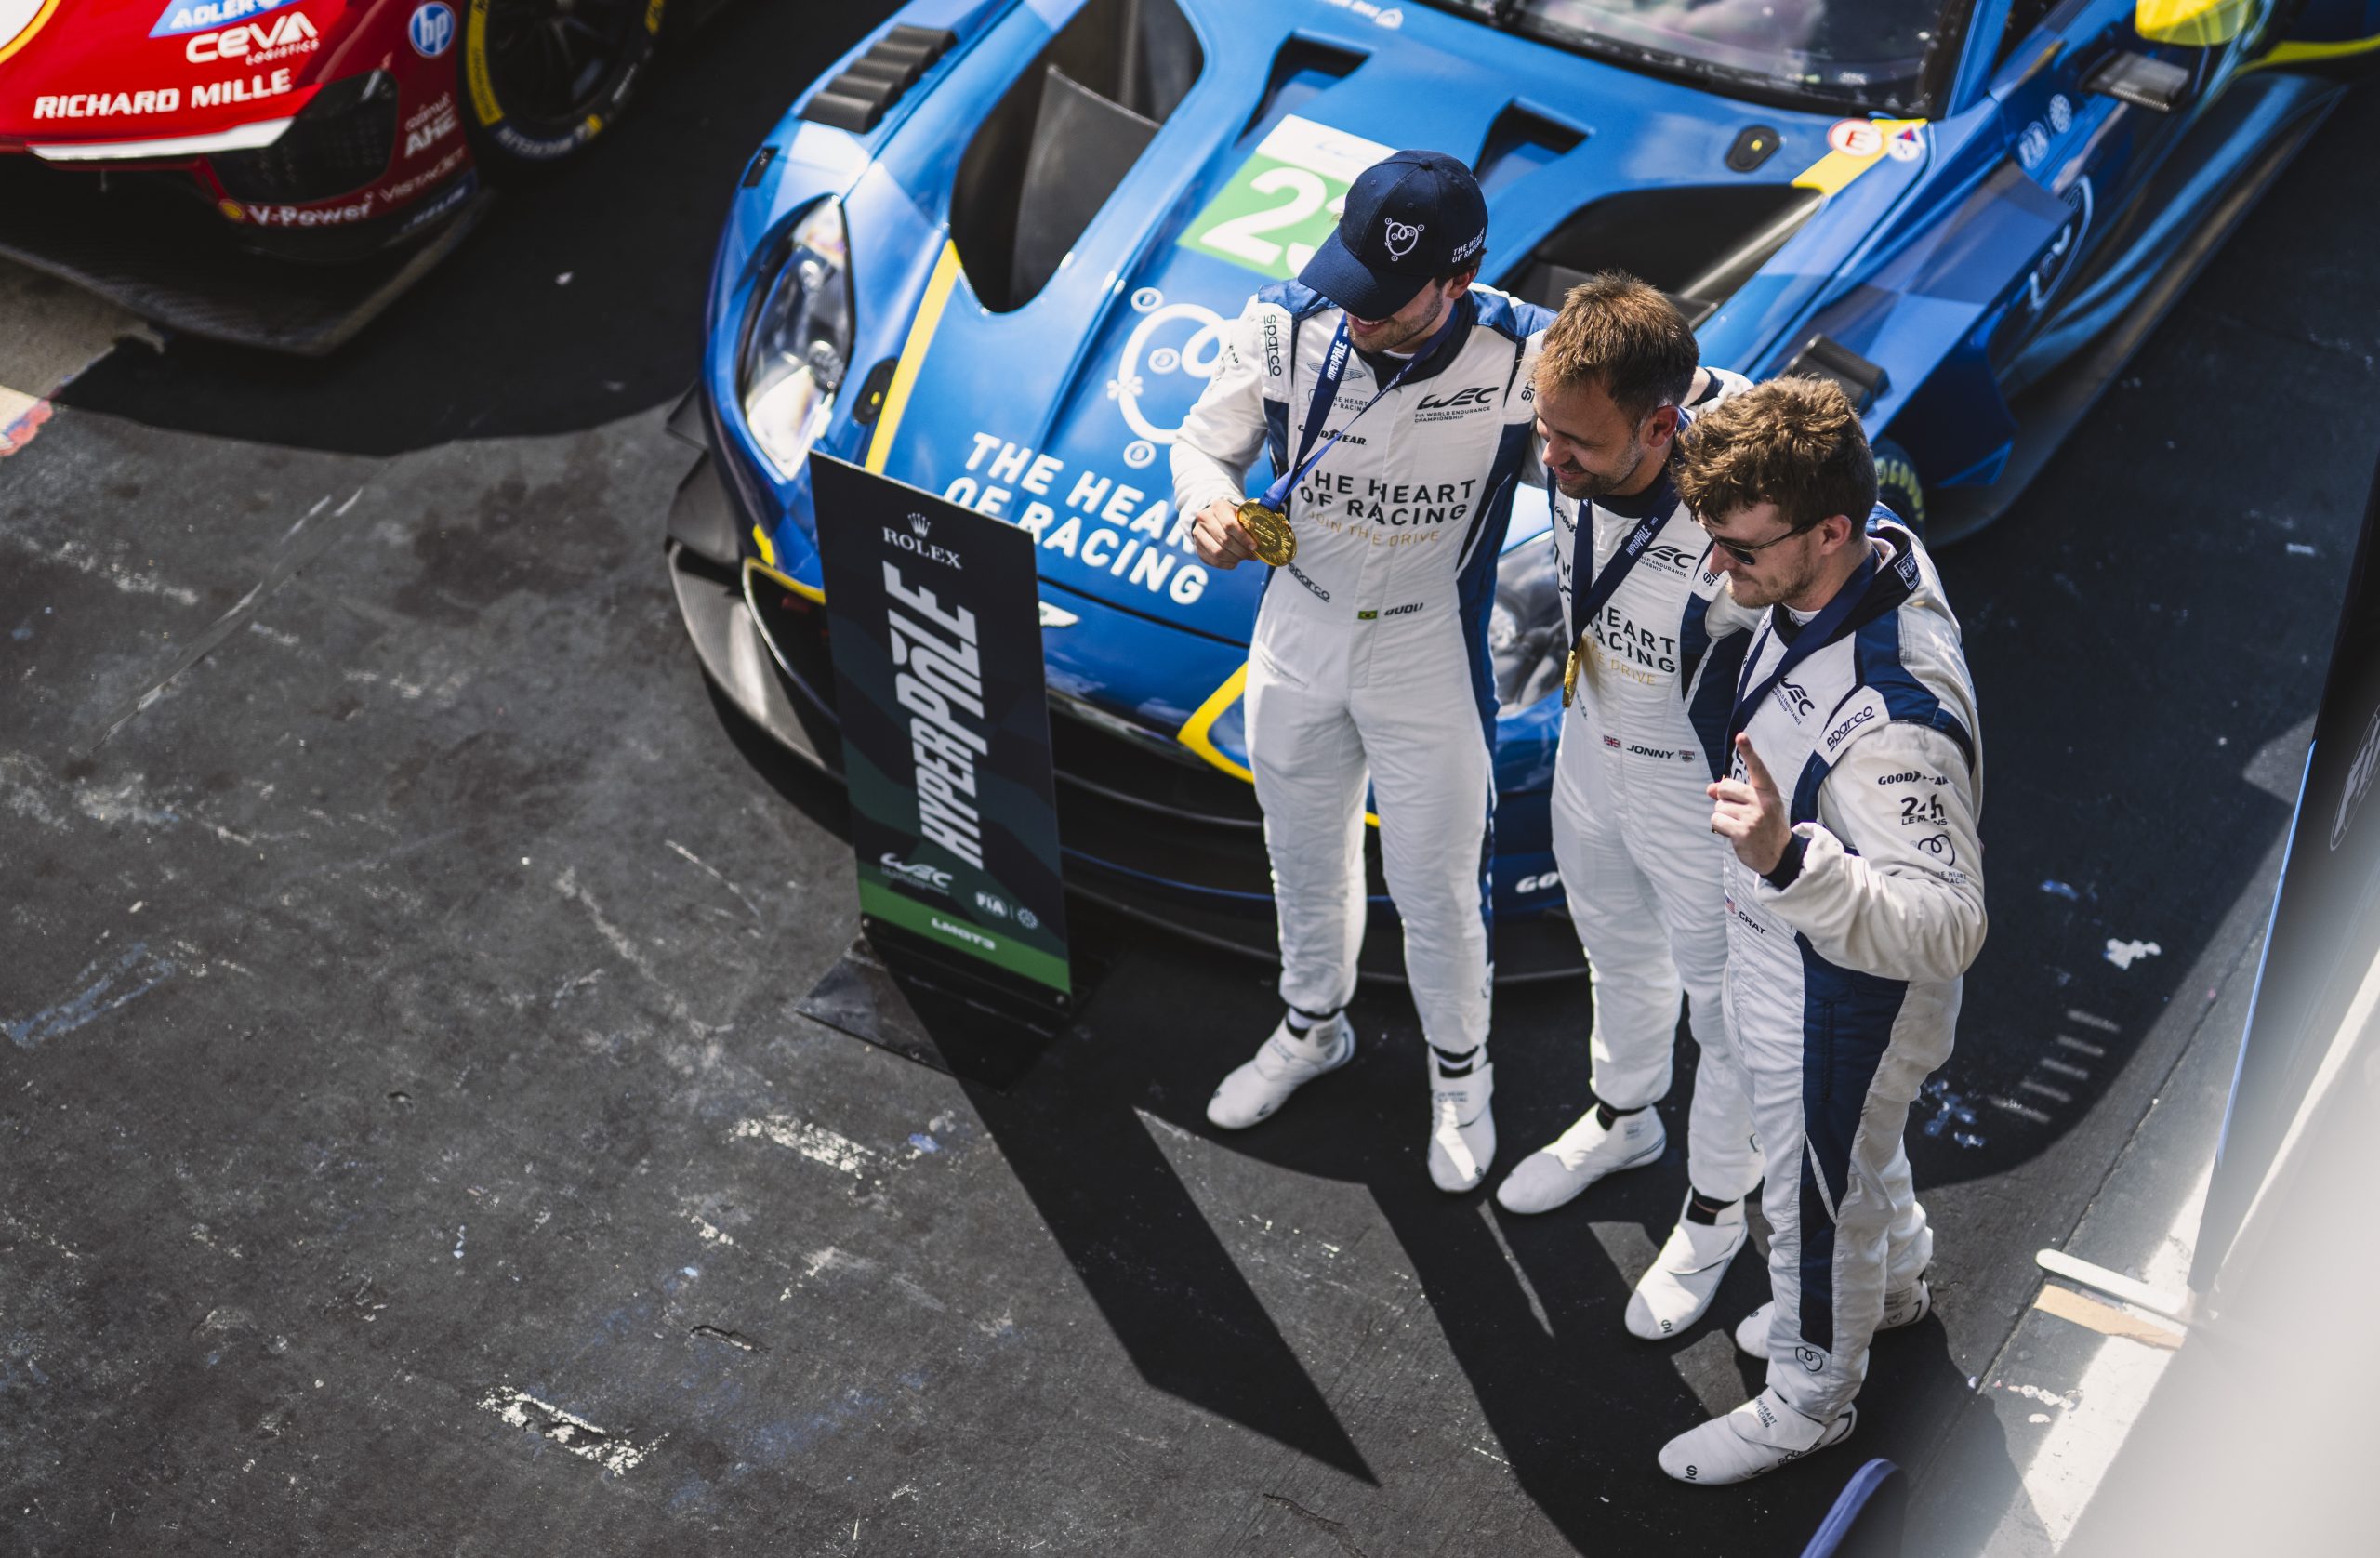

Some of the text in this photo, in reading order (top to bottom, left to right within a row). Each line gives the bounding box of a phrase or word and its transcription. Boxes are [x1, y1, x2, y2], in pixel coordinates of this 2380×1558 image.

[418, 5, 450, 54] hp
[245, 38, 320, 66] LOGISTICS
[33, 67, 293, 119] RICHARD MILLE
[1452, 253, 1463, 263] OF
[1453, 244, 1468, 256] THE
[1264, 314, 1282, 377] sparco
[1344, 398, 1368, 407] HEART
[1451, 405, 1491, 416] ENDURANCE
[1414, 415, 1464, 423] CHAMPIONSHIP
[965, 431, 1064, 496] THE
[1302, 469, 1476, 504] HE HEART
[1300, 486, 1468, 526] OF RACING
[1309, 511, 1440, 548] JOIN THE DRIVE
[881, 525, 962, 570] ROLEX
[1018, 501, 1209, 605] RACING
[1288, 562, 1331, 602] sparco
[1651, 560, 1687, 577] ENDURANCE
[1901, 559, 1916, 577] FIA
[1599, 607, 1676, 655] EART
[1589, 623, 1676, 673] ACING
[1610, 658, 1656, 685] DRIVE
[1826, 706, 1875, 753] sparco
[1626, 744, 1675, 759] JONNY
[1901, 817, 1915, 825] LE
[976, 891, 1006, 917] FIA
[1739, 910, 1767, 935] GRAY
